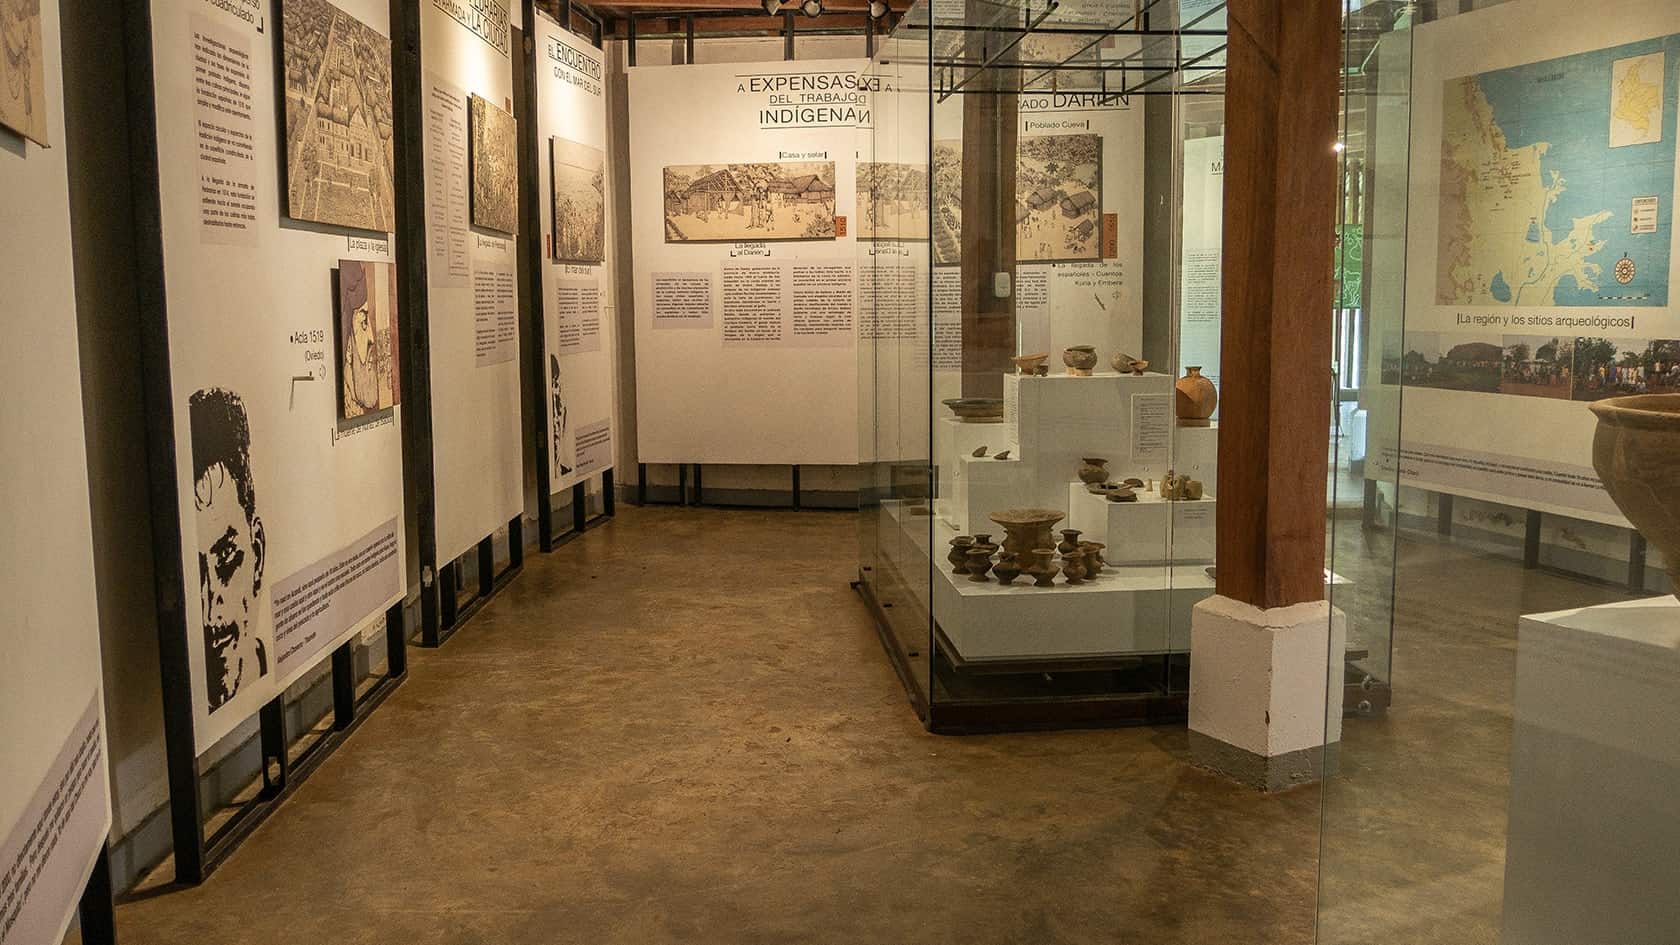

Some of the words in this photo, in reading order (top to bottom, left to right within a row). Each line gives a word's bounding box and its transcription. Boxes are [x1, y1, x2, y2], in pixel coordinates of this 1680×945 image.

[557, 43, 601, 80] ENCUENTRO
[737, 84, 746, 93] A
[750, 75, 856, 93] EXPENSAS
[769, 95, 793, 103] DEL
[800, 92, 857, 103] TRABAJO
[1017, 98, 1049, 109] ADO
[760, 105, 857, 124] INDÍGENA
[782, 151, 800, 159] Casa
[1460, 313, 1471, 324] La
[1473, 313, 1501, 327] región
[1503, 316, 1509, 327] y
[1511, 314, 1526, 325] los
[1527, 314, 1553, 326] sitios
[1555, 315, 1631, 329] arqueológicos
